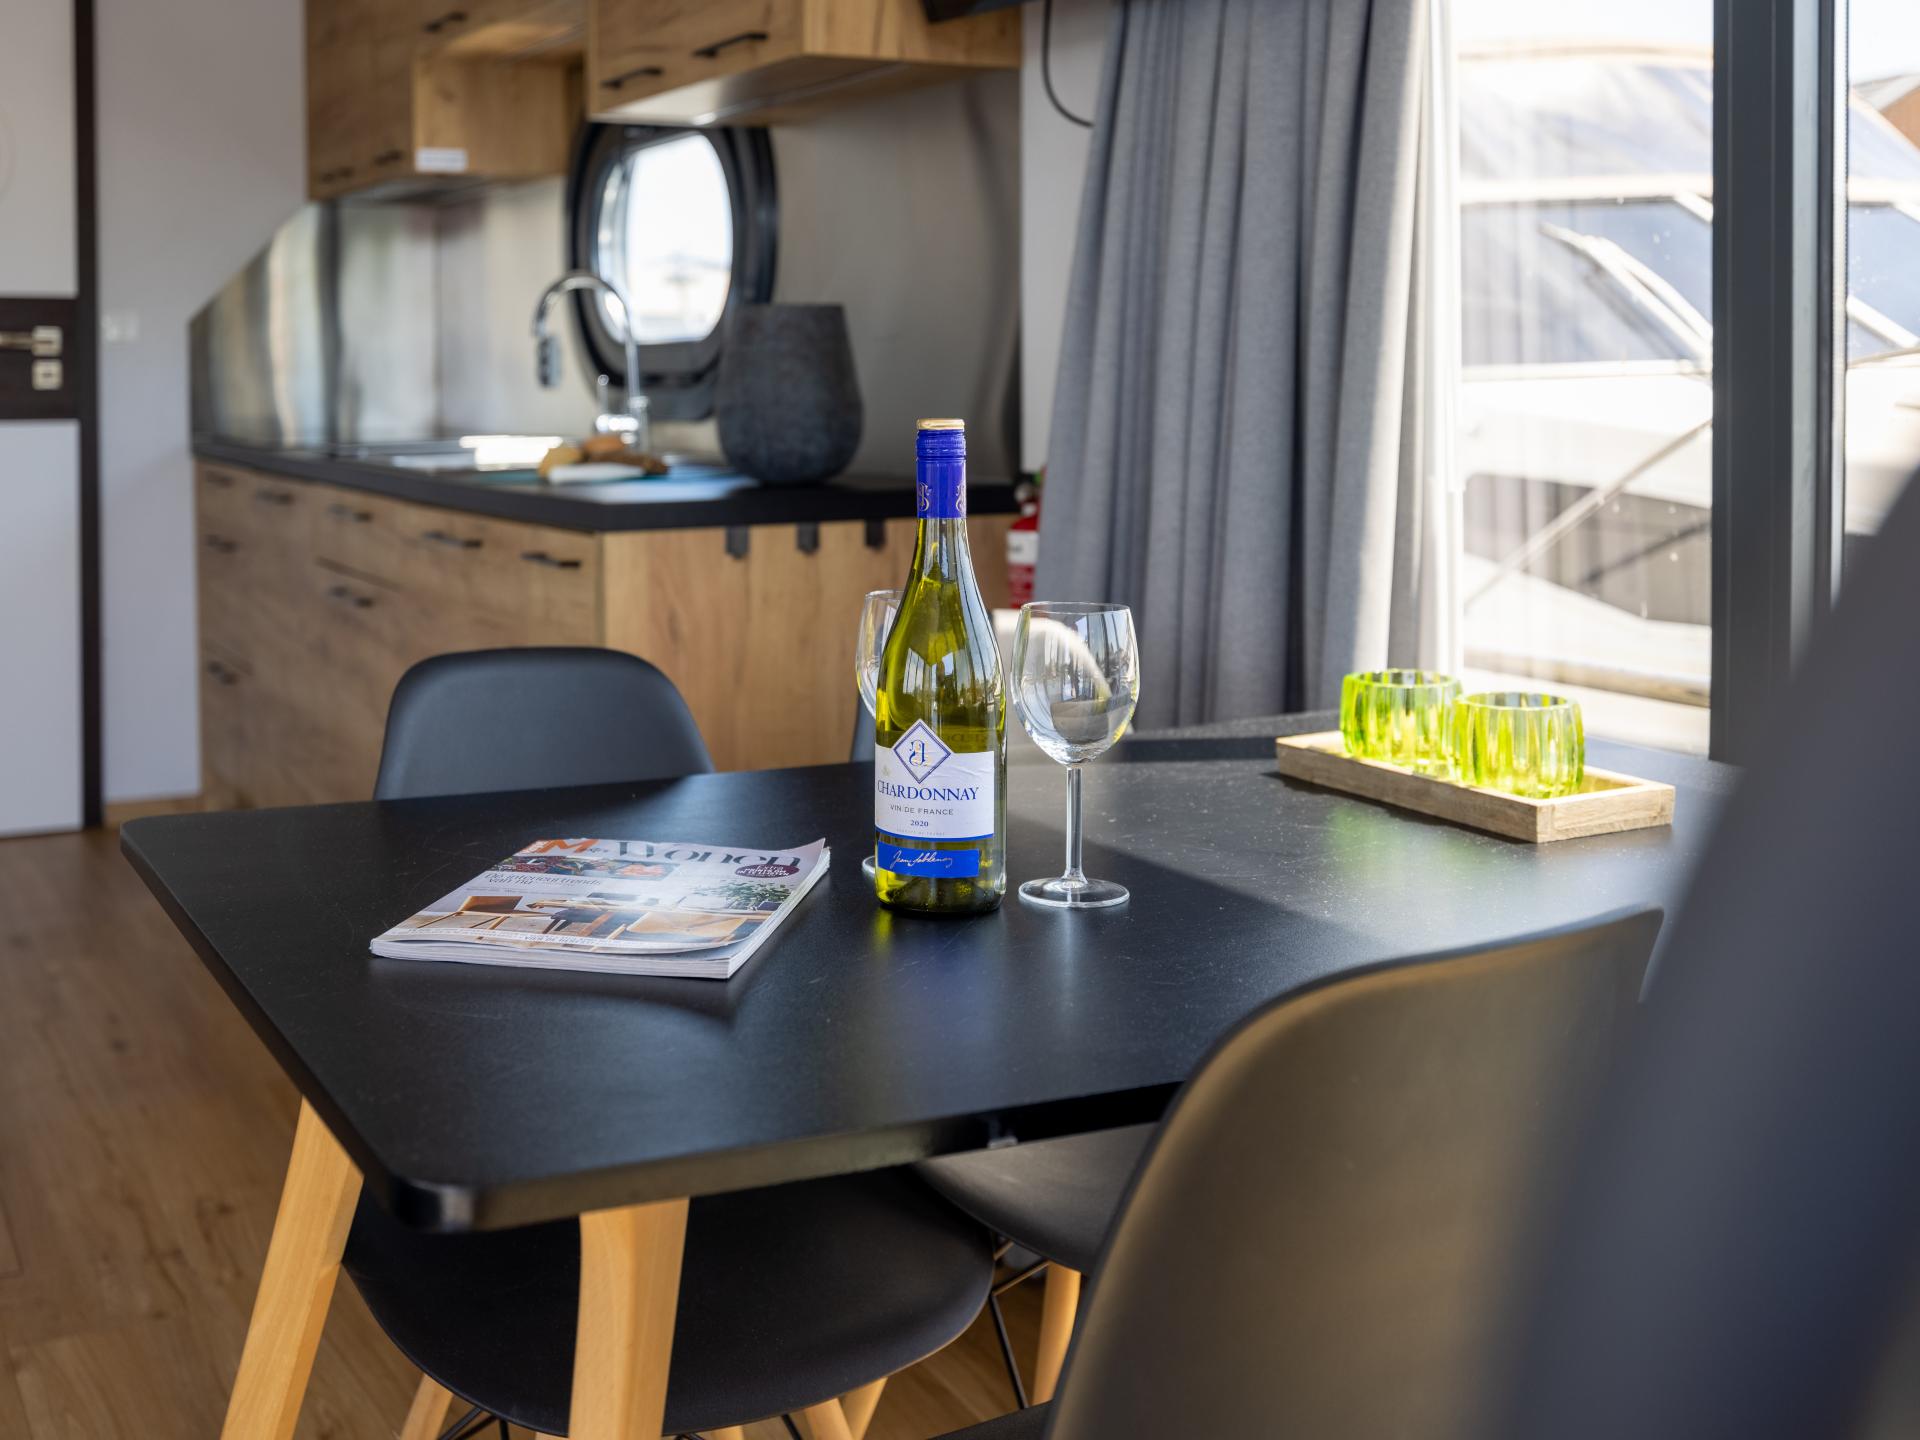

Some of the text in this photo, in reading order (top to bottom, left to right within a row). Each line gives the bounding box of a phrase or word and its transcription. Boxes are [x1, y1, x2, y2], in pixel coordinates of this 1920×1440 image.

[877, 779, 979, 801] CHARDONNAY
[890, 804, 954, 816] VIN DE FRANCE
[910, 819, 929, 828] 2020
